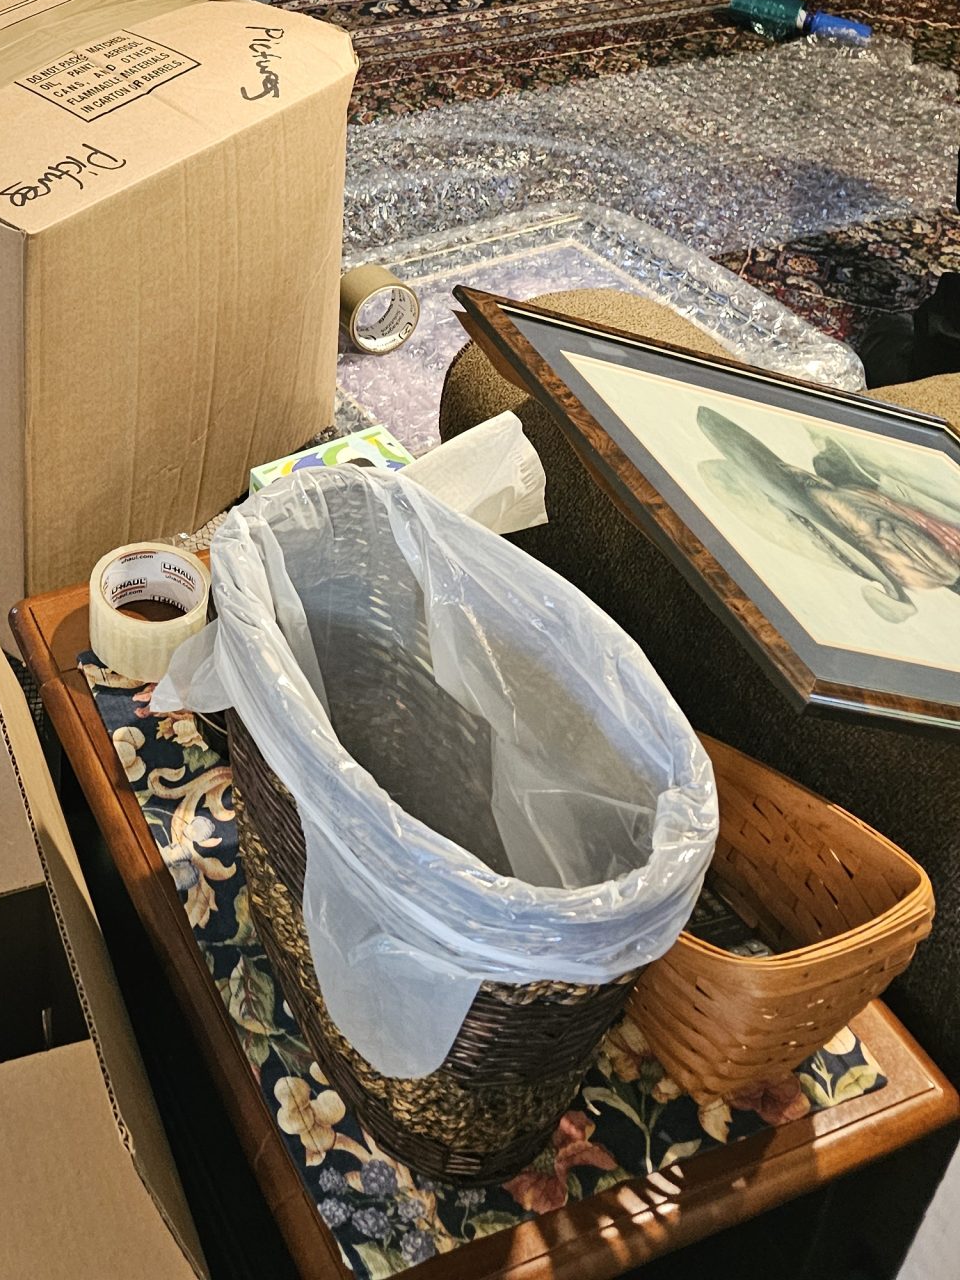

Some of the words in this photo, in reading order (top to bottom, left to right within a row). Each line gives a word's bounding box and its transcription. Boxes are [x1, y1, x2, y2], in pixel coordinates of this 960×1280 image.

[26, 75, 41, 84] DO
[40, 65, 61, 78] NOT
[85, 35, 131, 54] MATCHES,
[40, 79, 62, 91] OIL,
[103, 40, 144, 59] AEROSOL
[53, 81, 91, 98] CANS,
[95, 64, 117, 79] AND
[120, 45, 156, 64] OTHER
[66, 76, 122, 106] FLAMMABLE
[120, 52, 170, 79] MATERIALS
[81, 104, 96, 114] IN
[92, 86, 131, 108] CARTON
[132, 79, 145, 91] OR
[141, 60, 186, 82] BARRELS.
[112, 578, 145, 595] U-HAUL
[163, 562, 196, 585] U-HAUL
